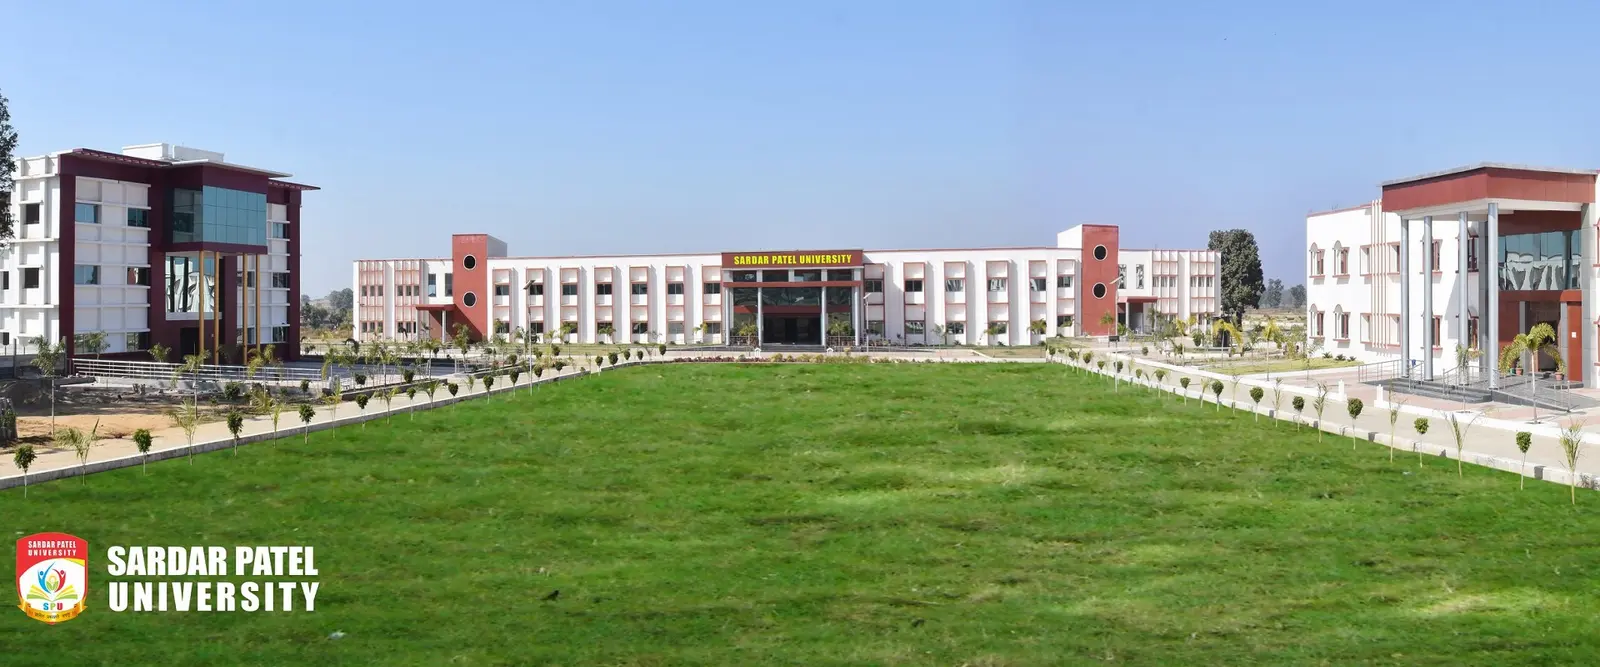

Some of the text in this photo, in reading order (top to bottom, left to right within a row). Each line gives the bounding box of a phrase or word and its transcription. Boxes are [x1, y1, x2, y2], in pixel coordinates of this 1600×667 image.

[734, 254, 852, 265] SARDAR PATEL UNIVERSITY
